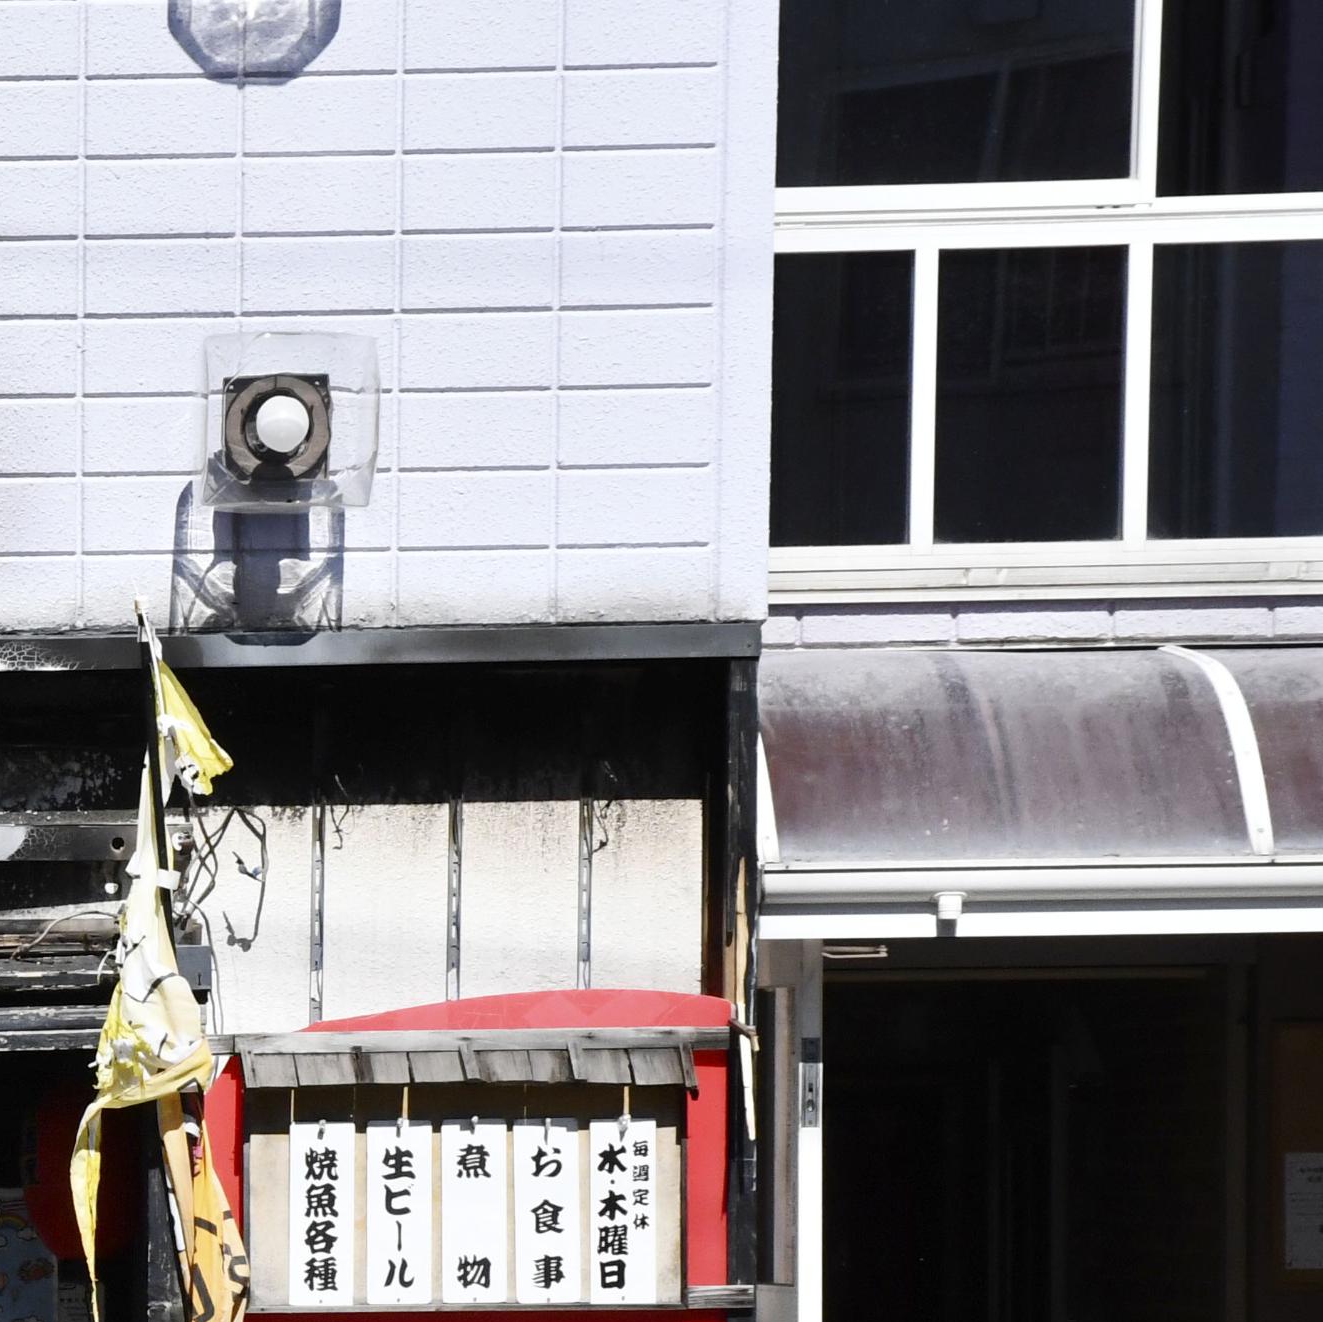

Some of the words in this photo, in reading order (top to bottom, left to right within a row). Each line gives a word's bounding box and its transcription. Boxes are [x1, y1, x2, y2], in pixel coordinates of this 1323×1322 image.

[303, 1147, 339, 1292] 焼魚各種
[381, 1146, 416, 1289] 生ビール
[456, 1144, 491, 1289] 煮物
[530, 1145, 565, 1289] お食事
[632, 1140, 650, 1230] 毎週定休
